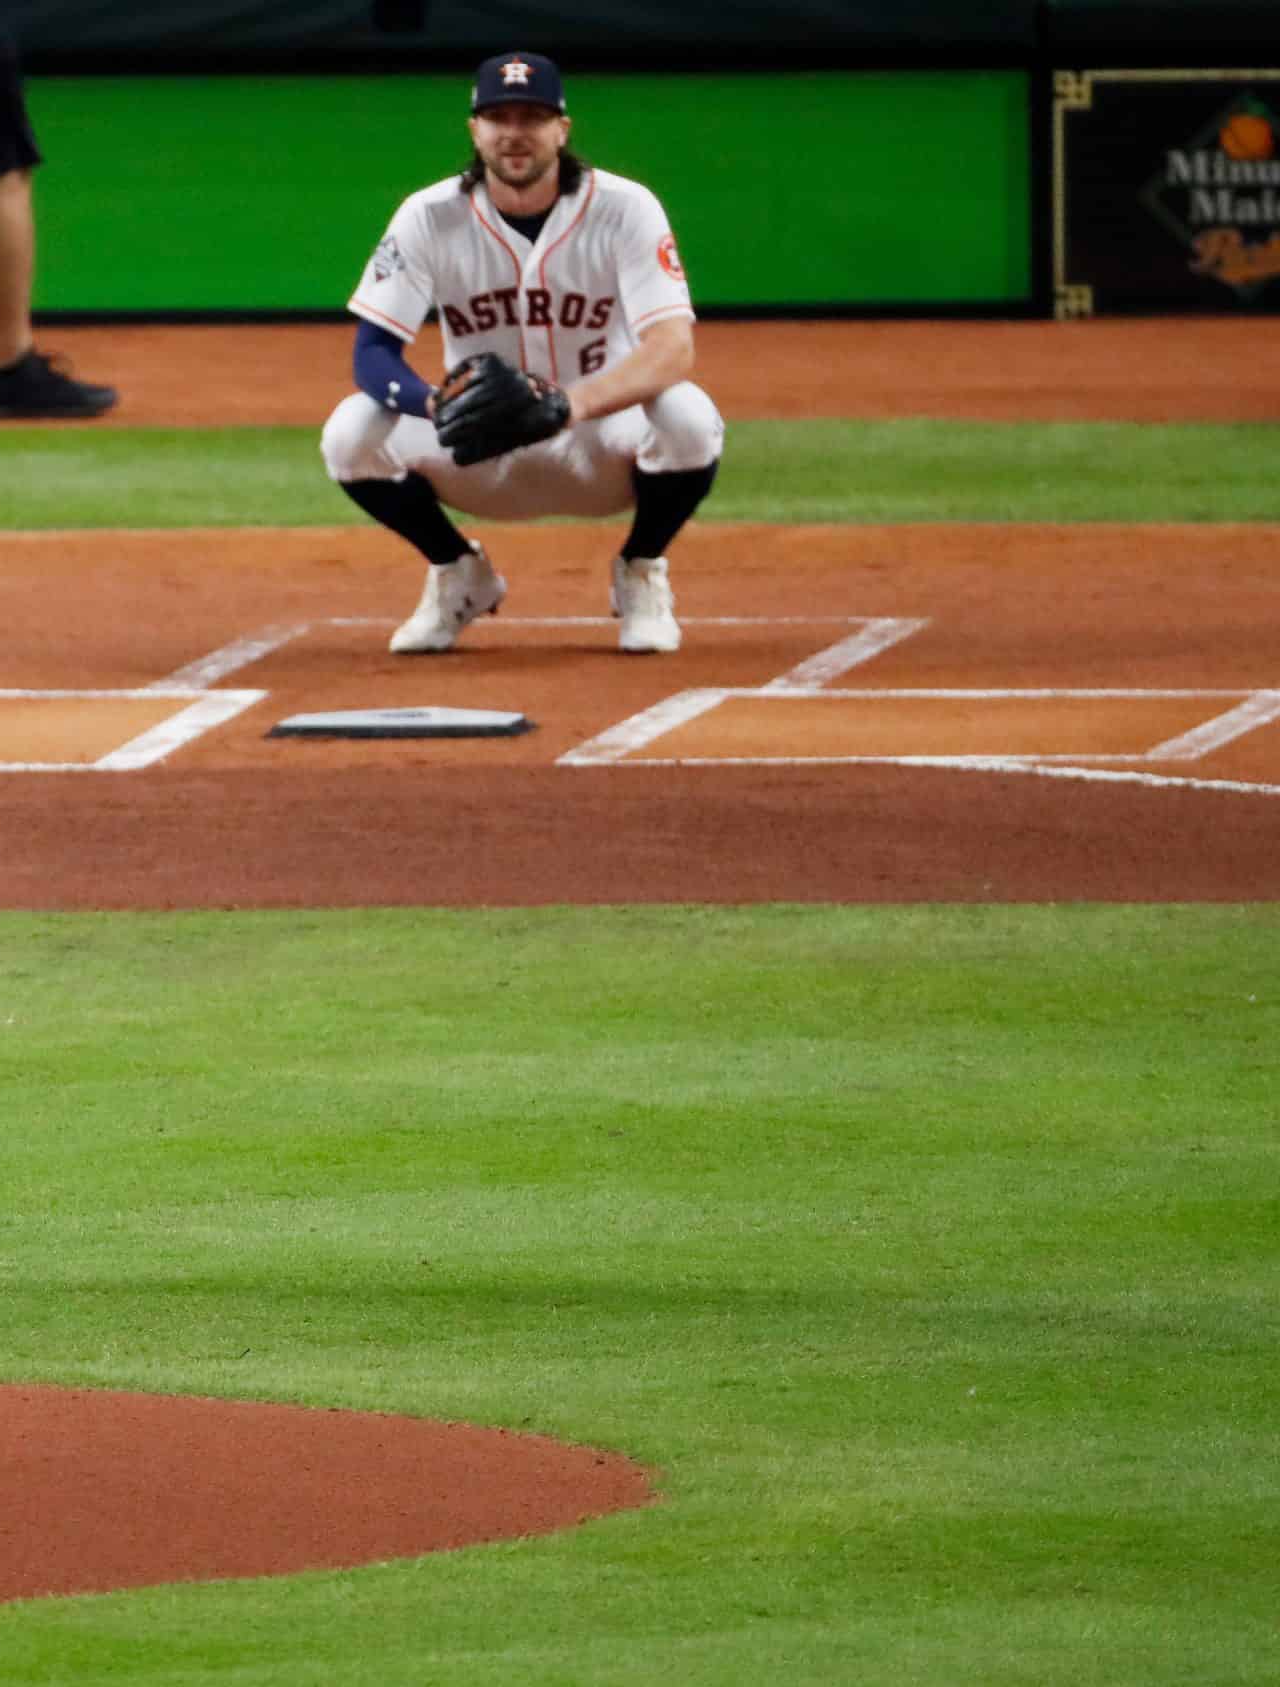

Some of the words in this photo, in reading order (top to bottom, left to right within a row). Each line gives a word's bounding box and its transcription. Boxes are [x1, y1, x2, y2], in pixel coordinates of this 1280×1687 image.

[1188, 189, 1280, 222] Mai
[442, 287, 615, 337] ASTROS
[579, 336, 607, 377] 6
